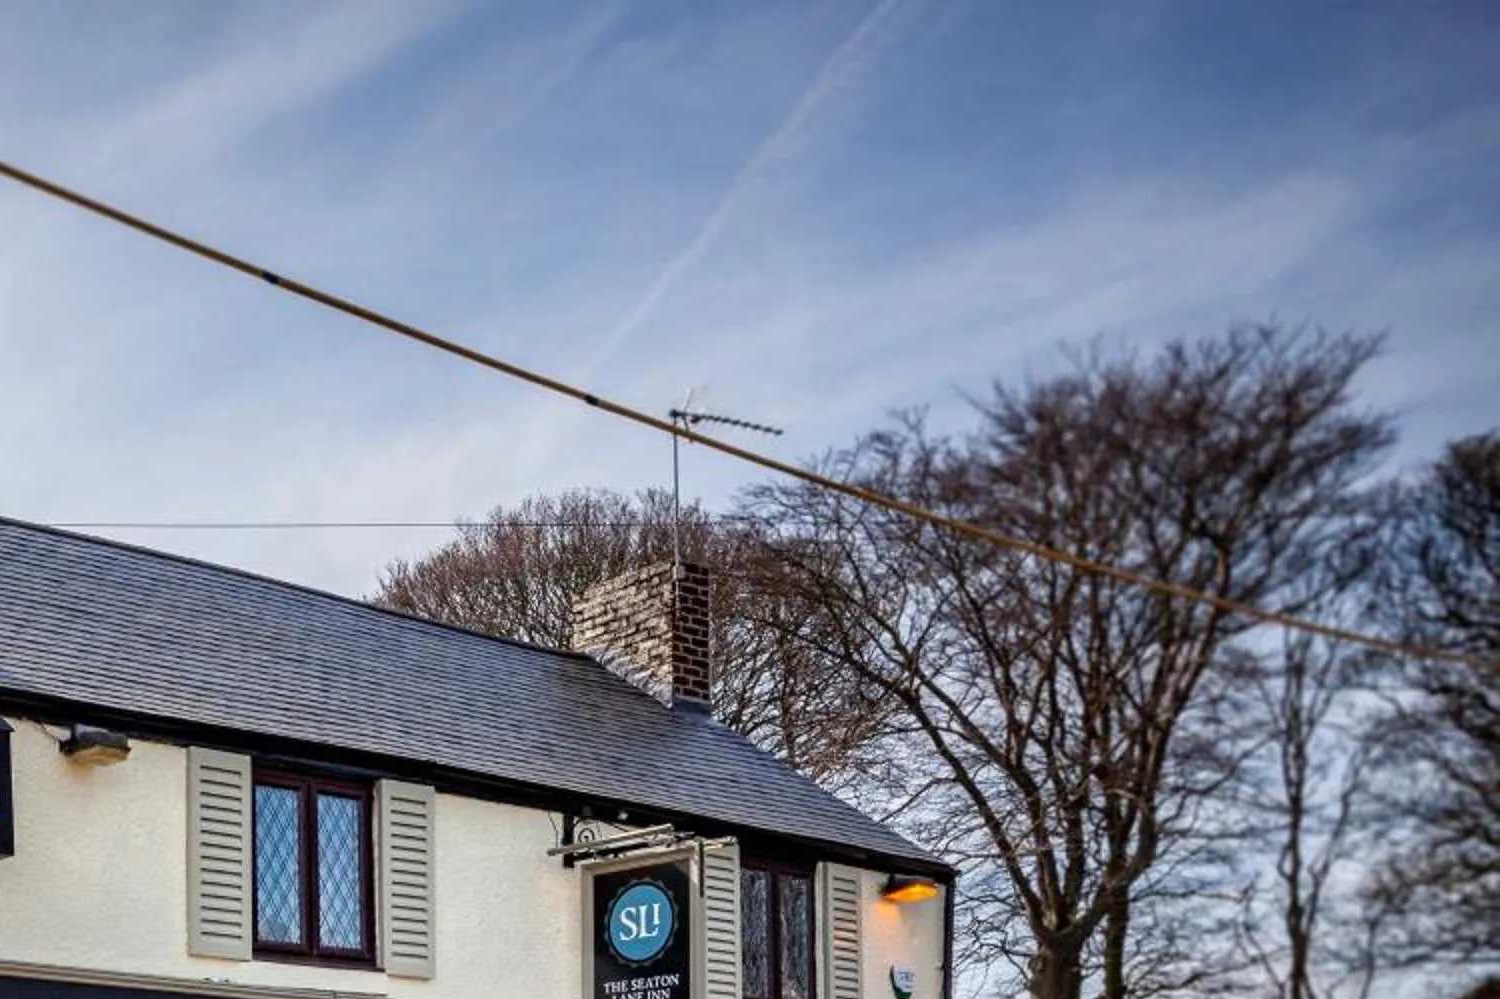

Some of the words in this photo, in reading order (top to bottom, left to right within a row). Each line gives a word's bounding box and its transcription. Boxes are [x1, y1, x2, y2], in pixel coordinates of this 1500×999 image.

[619, 903, 661, 941] SLI
[604, 980, 629, 994] THE
[631, 974, 680, 991] SEATON
